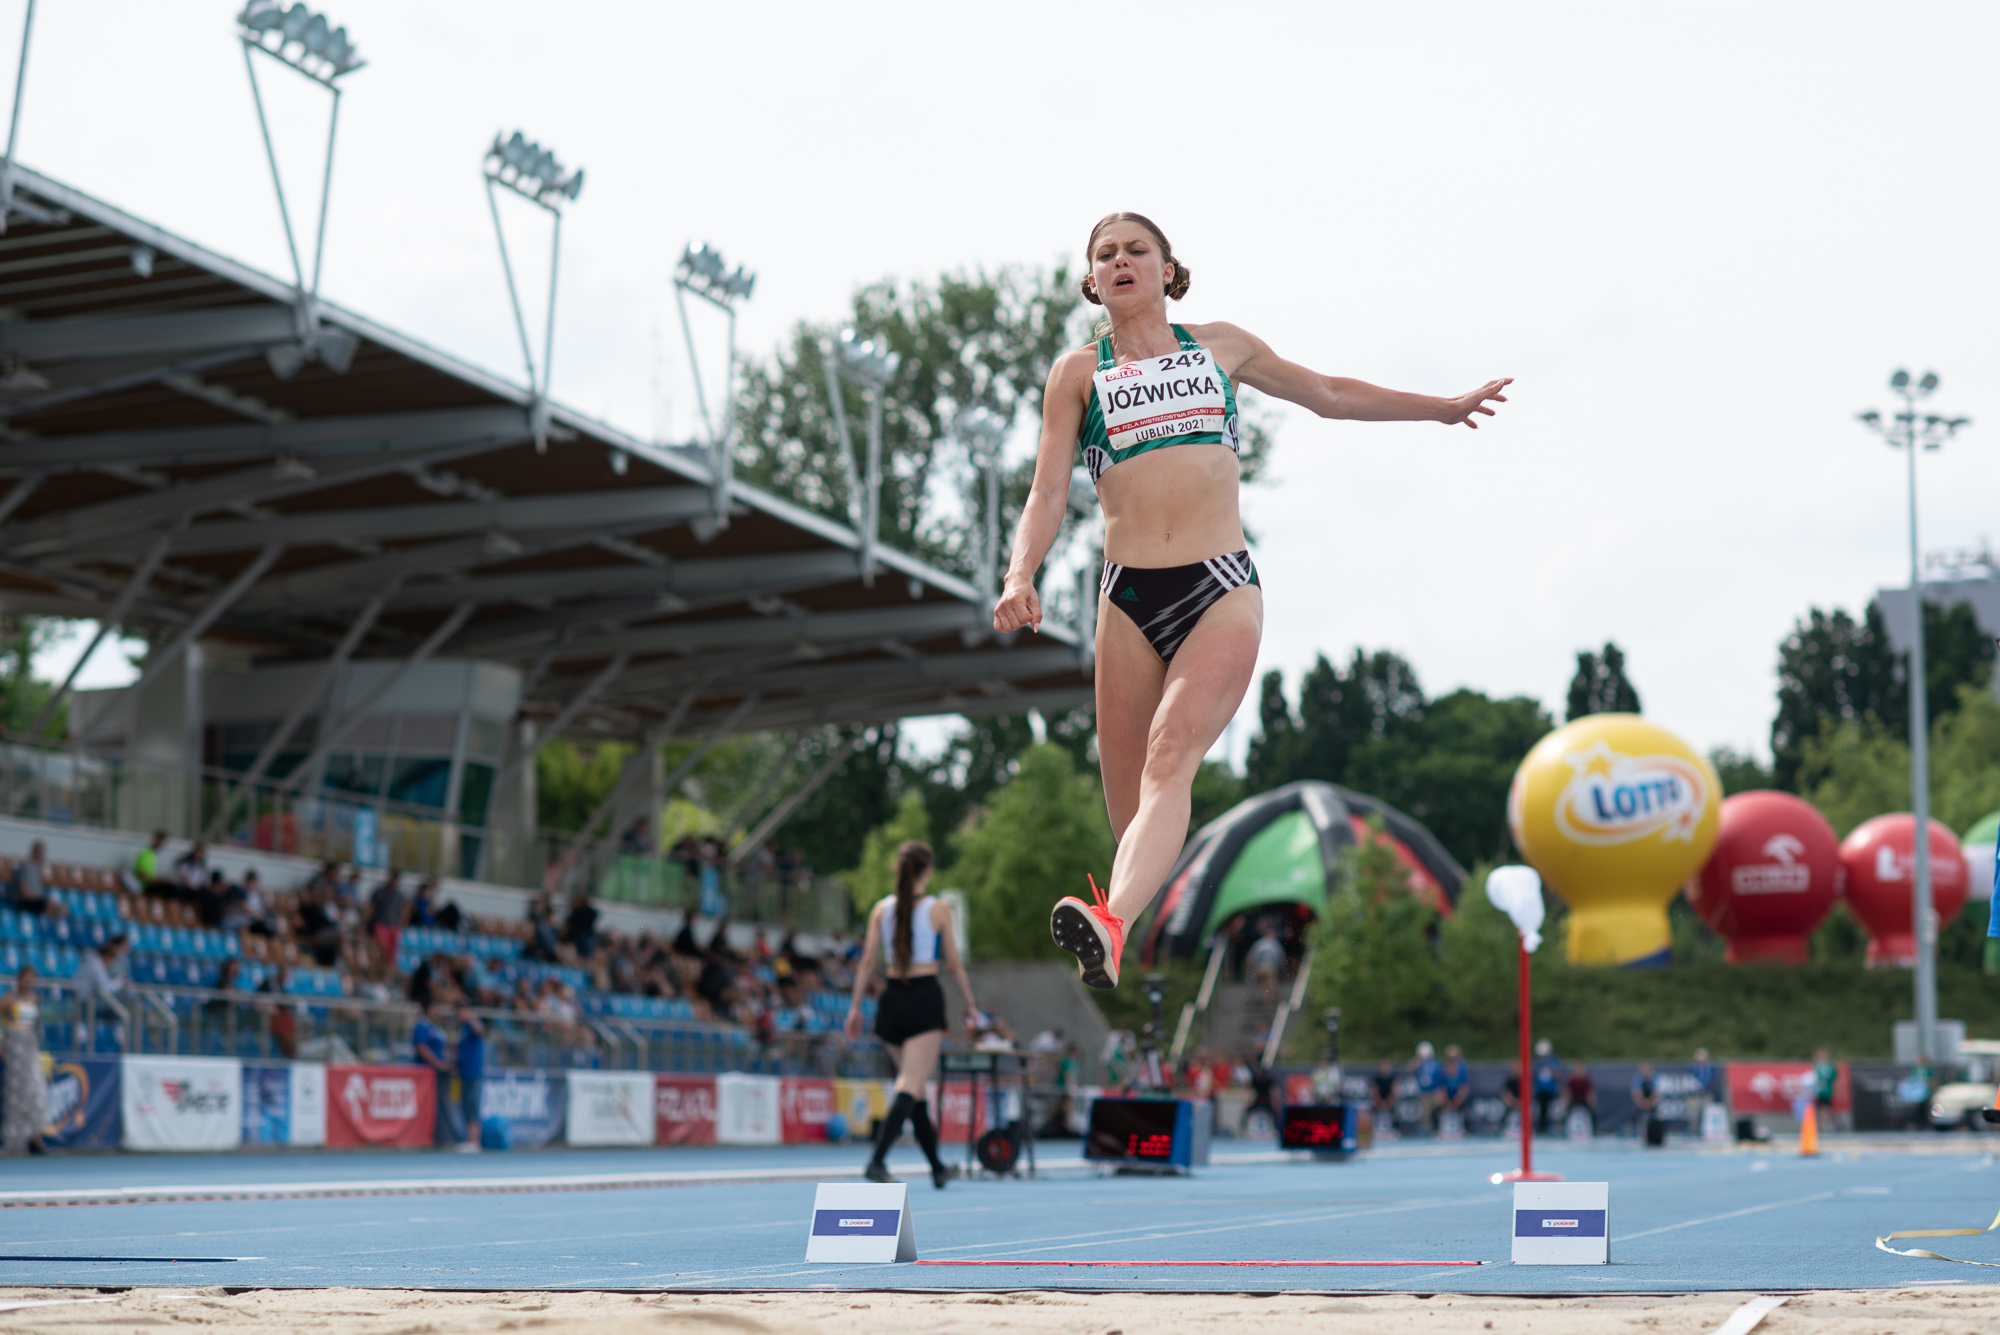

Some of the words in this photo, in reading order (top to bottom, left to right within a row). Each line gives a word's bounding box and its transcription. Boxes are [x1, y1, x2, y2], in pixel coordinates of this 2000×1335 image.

[1158, 351, 1206, 371] 249
[1106, 369, 1142, 381] ORLEN
[1107, 376, 1219, 414] JÓŹWICKA
[1140, 412, 1187, 426] MISTRZOSTWA
[1135, 424, 1175, 442] LUBLIN
[1178, 418, 1204, 433] 2021
